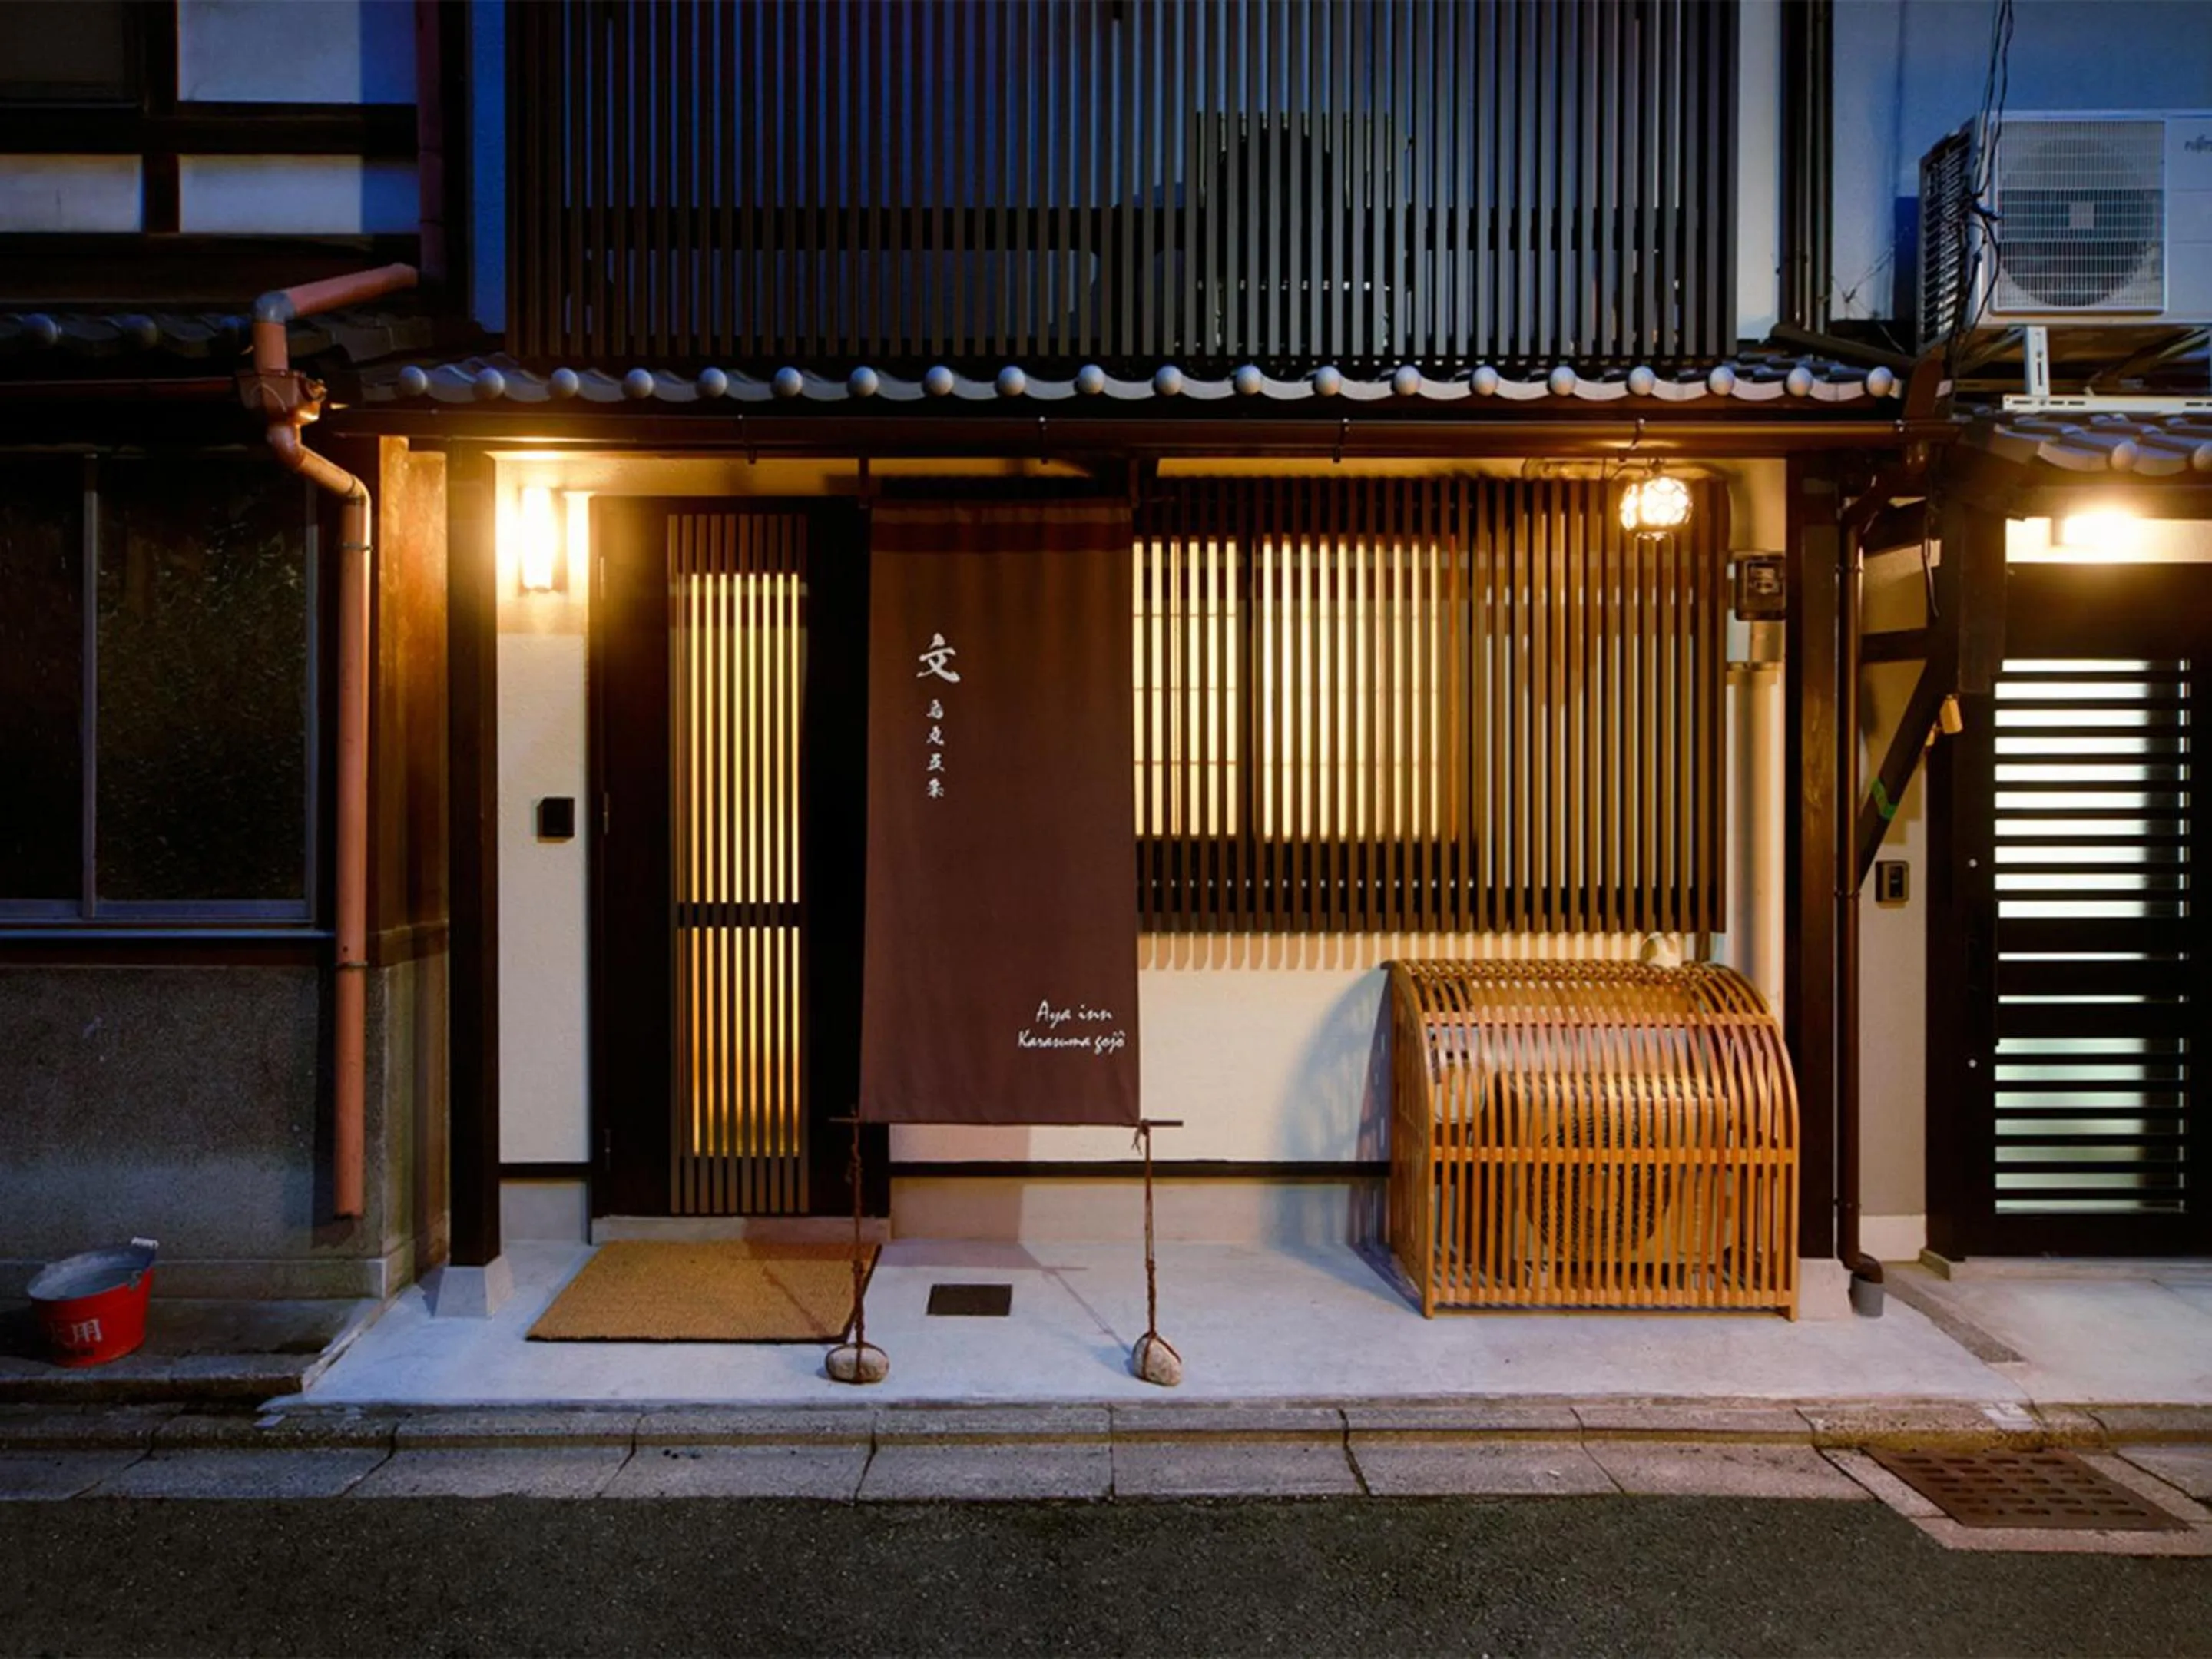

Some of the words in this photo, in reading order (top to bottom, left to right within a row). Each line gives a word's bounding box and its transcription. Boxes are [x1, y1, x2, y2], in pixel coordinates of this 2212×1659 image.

[916, 632, 960, 683] 文
[1036, 999, 1072, 1029] Aya
[1078, 1003, 1113, 1020] inn
[1018, 1029, 1091, 1048] Karasuma
